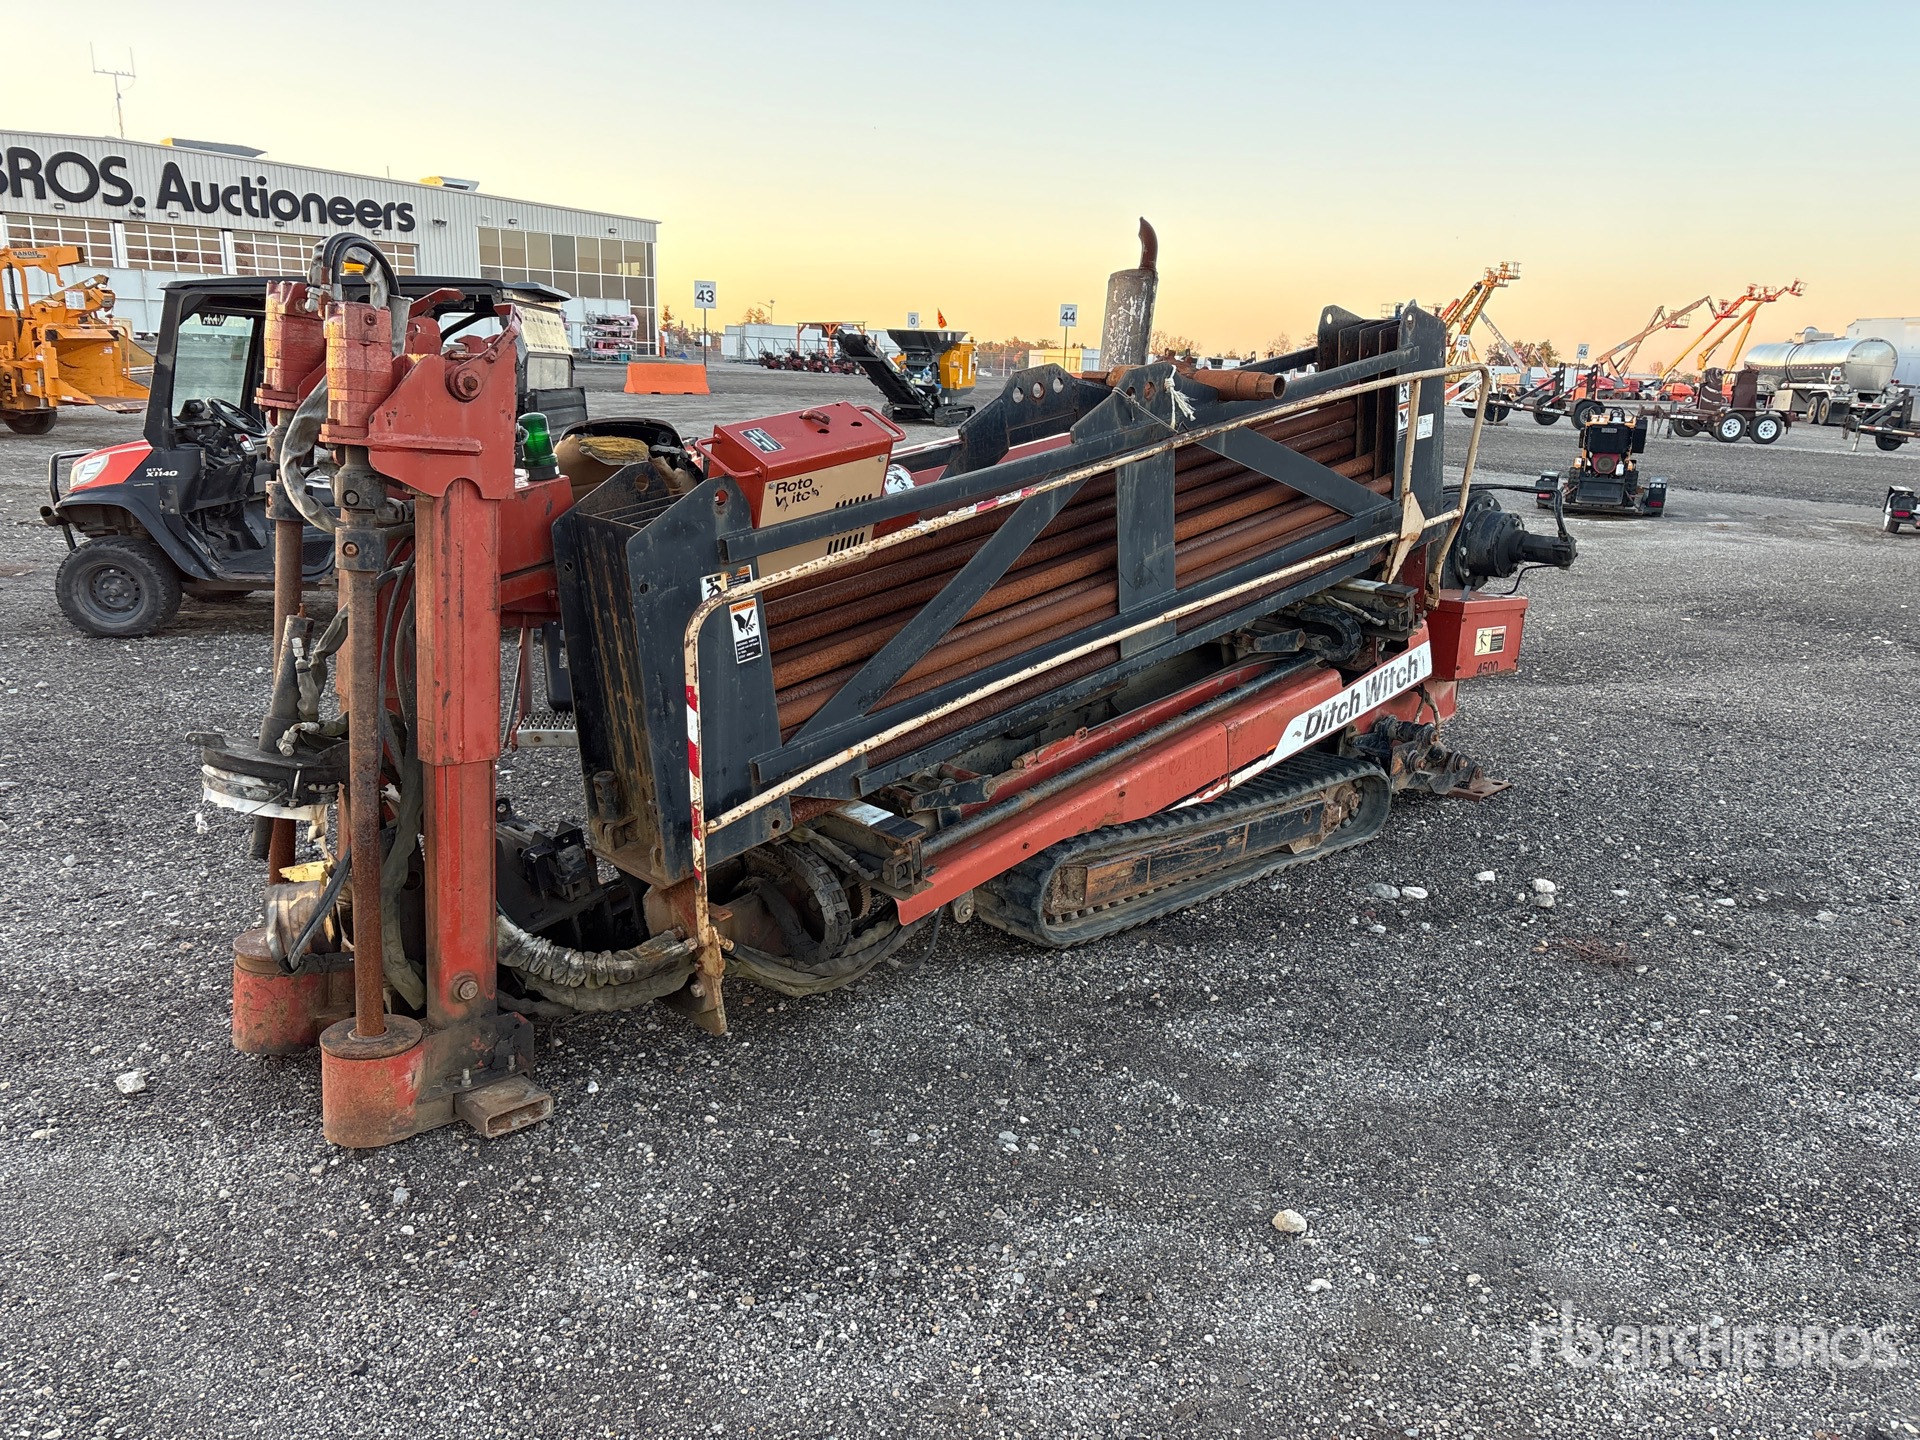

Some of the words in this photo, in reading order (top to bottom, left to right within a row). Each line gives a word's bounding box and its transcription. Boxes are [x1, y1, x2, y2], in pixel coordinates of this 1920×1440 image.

[0, 146, 146, 208] ROS.
[156, 160, 416, 233] Auctioneers
[696, 289, 714, 303] 43
[1061, 311, 1076, 322] 44
[1457, 339, 1468, 348] 45
[1578, 348, 1588, 356] 46
[775, 478, 812, 495] Roto
[1476, 661, 1499, 673] 4500
[1304, 688, 1361, 743] Ditch
[1365, 655, 1418, 707] Witch
